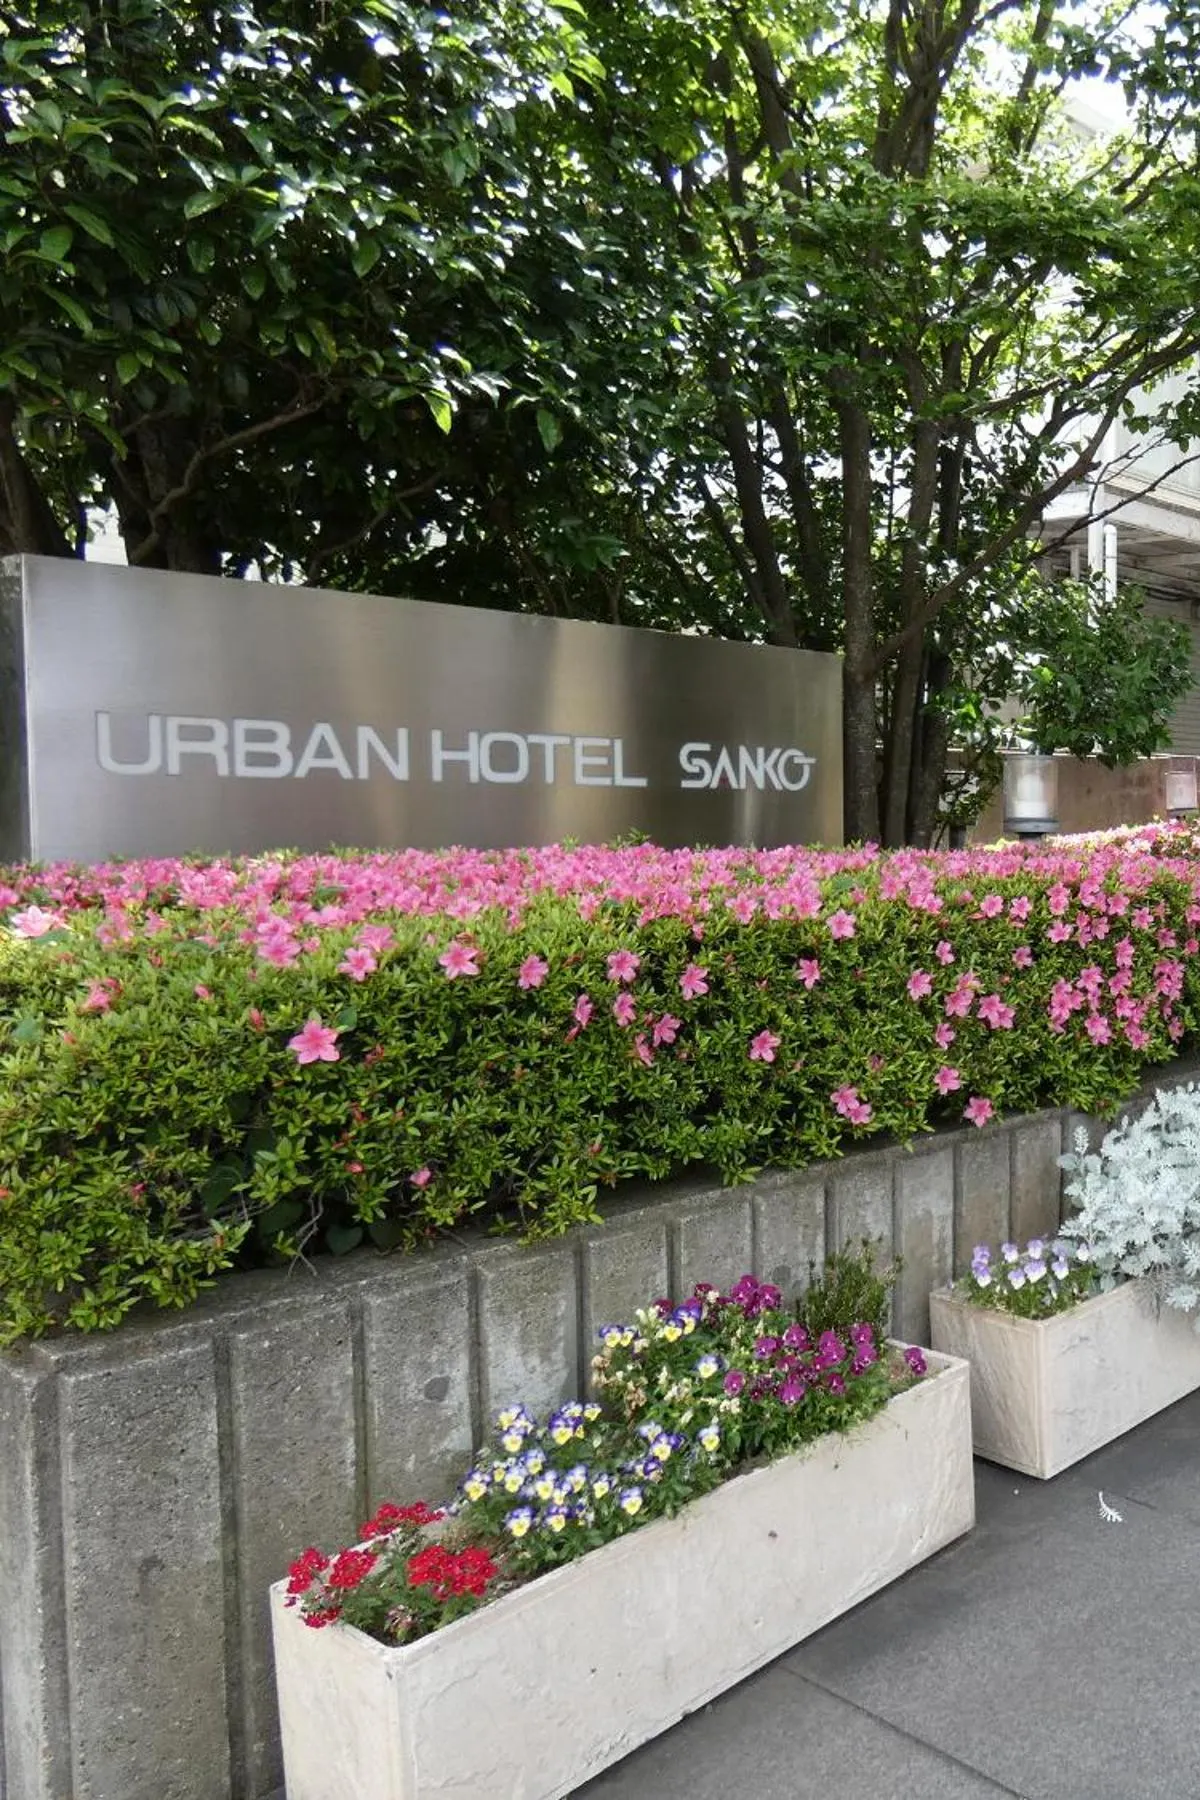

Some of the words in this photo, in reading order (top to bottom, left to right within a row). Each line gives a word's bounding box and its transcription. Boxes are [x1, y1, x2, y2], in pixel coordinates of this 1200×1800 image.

[95, 710, 410, 781] URBAN
[430, 729, 648, 788] HOTEL
[679, 742, 817, 792] SANKO
